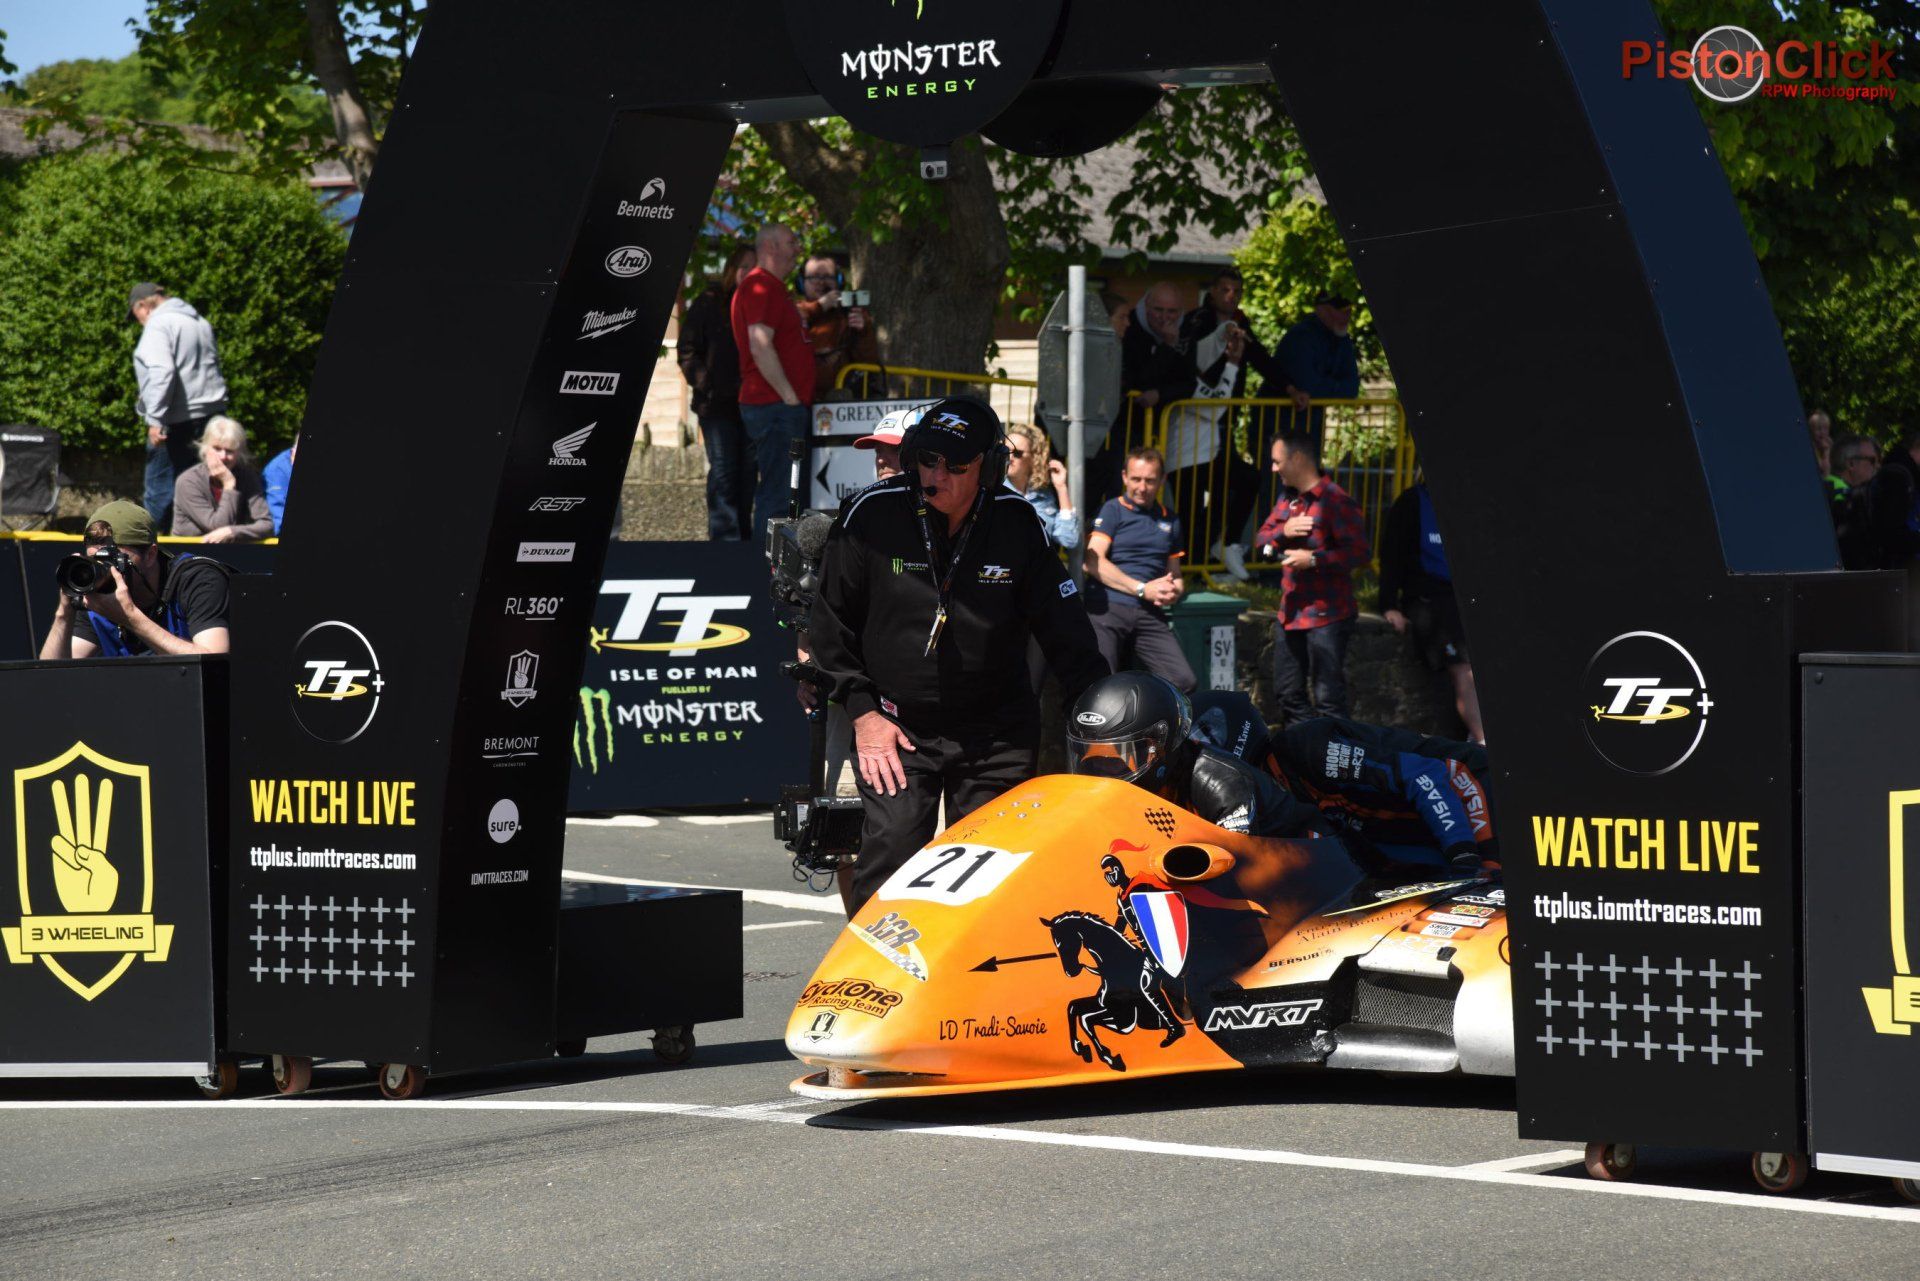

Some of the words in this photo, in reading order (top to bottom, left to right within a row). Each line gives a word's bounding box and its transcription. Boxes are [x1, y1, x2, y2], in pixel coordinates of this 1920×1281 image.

[841, 39, 1001, 80] MONSTER
[867, 78, 976, 99] ENERGY
[617, 200, 675, 220] Bennetts
[608, 250, 646, 268] Arai
[581, 307, 639, 332] Milwaukee
[563, 374, 616, 392] MOTUL
[938, 412, 969, 429] TT
[548, 457, 587, 466] HONDA
[528, 497, 586, 511] RST
[529, 548, 571, 556] DUNLOP
[982, 565, 1011, 579] TT
[599, 579, 751, 657] TT
[610, 669, 659, 681] ISLE
[667, 668, 696, 680] OF
[705, 666, 758, 679] MAN
[661, 686, 697, 694] FUELLED
[616, 698, 763, 729] MONSTER
[484, 737, 540, 751] BREMONT
[643, 731, 744, 744] ENERGY
[250, 779, 347, 824] WATCH
[357, 781, 416, 825] LIVE
[1415, 774, 1455, 832] VISAGE
[1453, 771, 1487, 834] VISAGE
[1532, 815, 1665, 870] WATCH
[1680, 820, 1760, 874] LIVE
[250, 844, 417, 871] ttplus.iomttraces.com
[471, 870, 529, 885] IOMTTRACES.COM
[906, 846, 997, 893] 21
[1533, 892, 1762, 926] ttplus.iomttraces.com
[32, 928, 44, 941] 3
[48, 926, 144, 940] WHEELING
[813, 997, 848, 1008] Racing
[852, 999, 884, 1015] Team
[963, 1015, 1047, 1039] Tradi-Savoie
